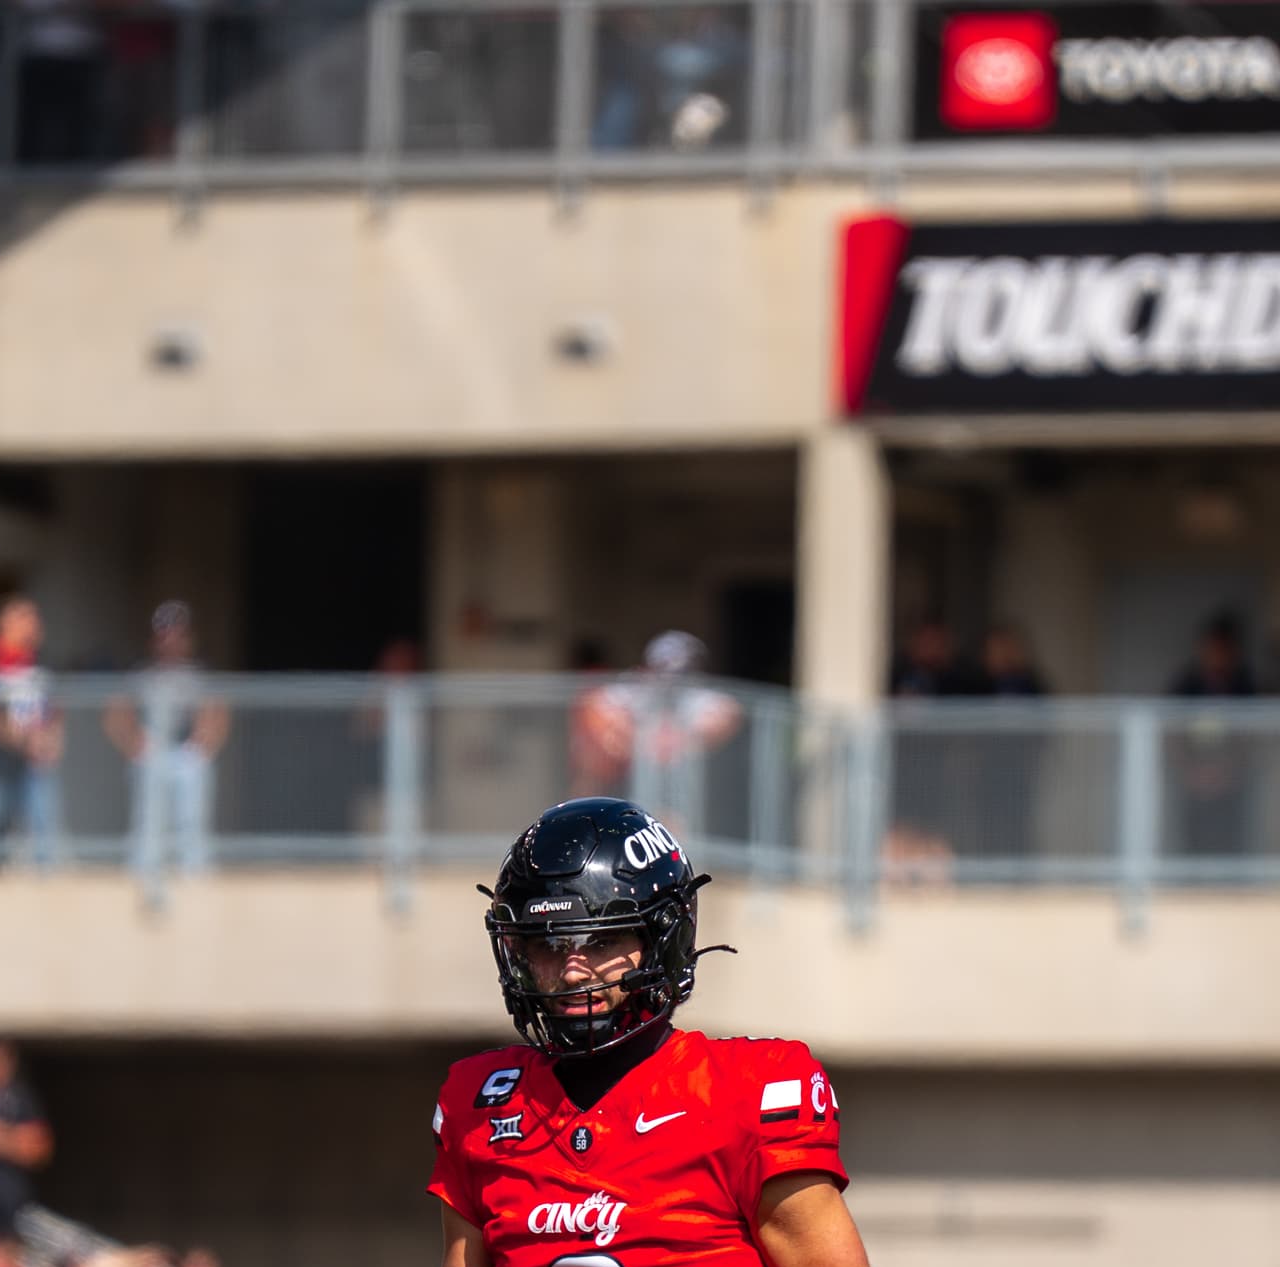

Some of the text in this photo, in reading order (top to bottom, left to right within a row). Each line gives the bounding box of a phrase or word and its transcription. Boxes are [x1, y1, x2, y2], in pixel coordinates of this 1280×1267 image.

[529, 901, 572, 914] CINCINNATI
[481, 1068, 521, 1097] C
[527, 1191, 627, 1247] CINCY
